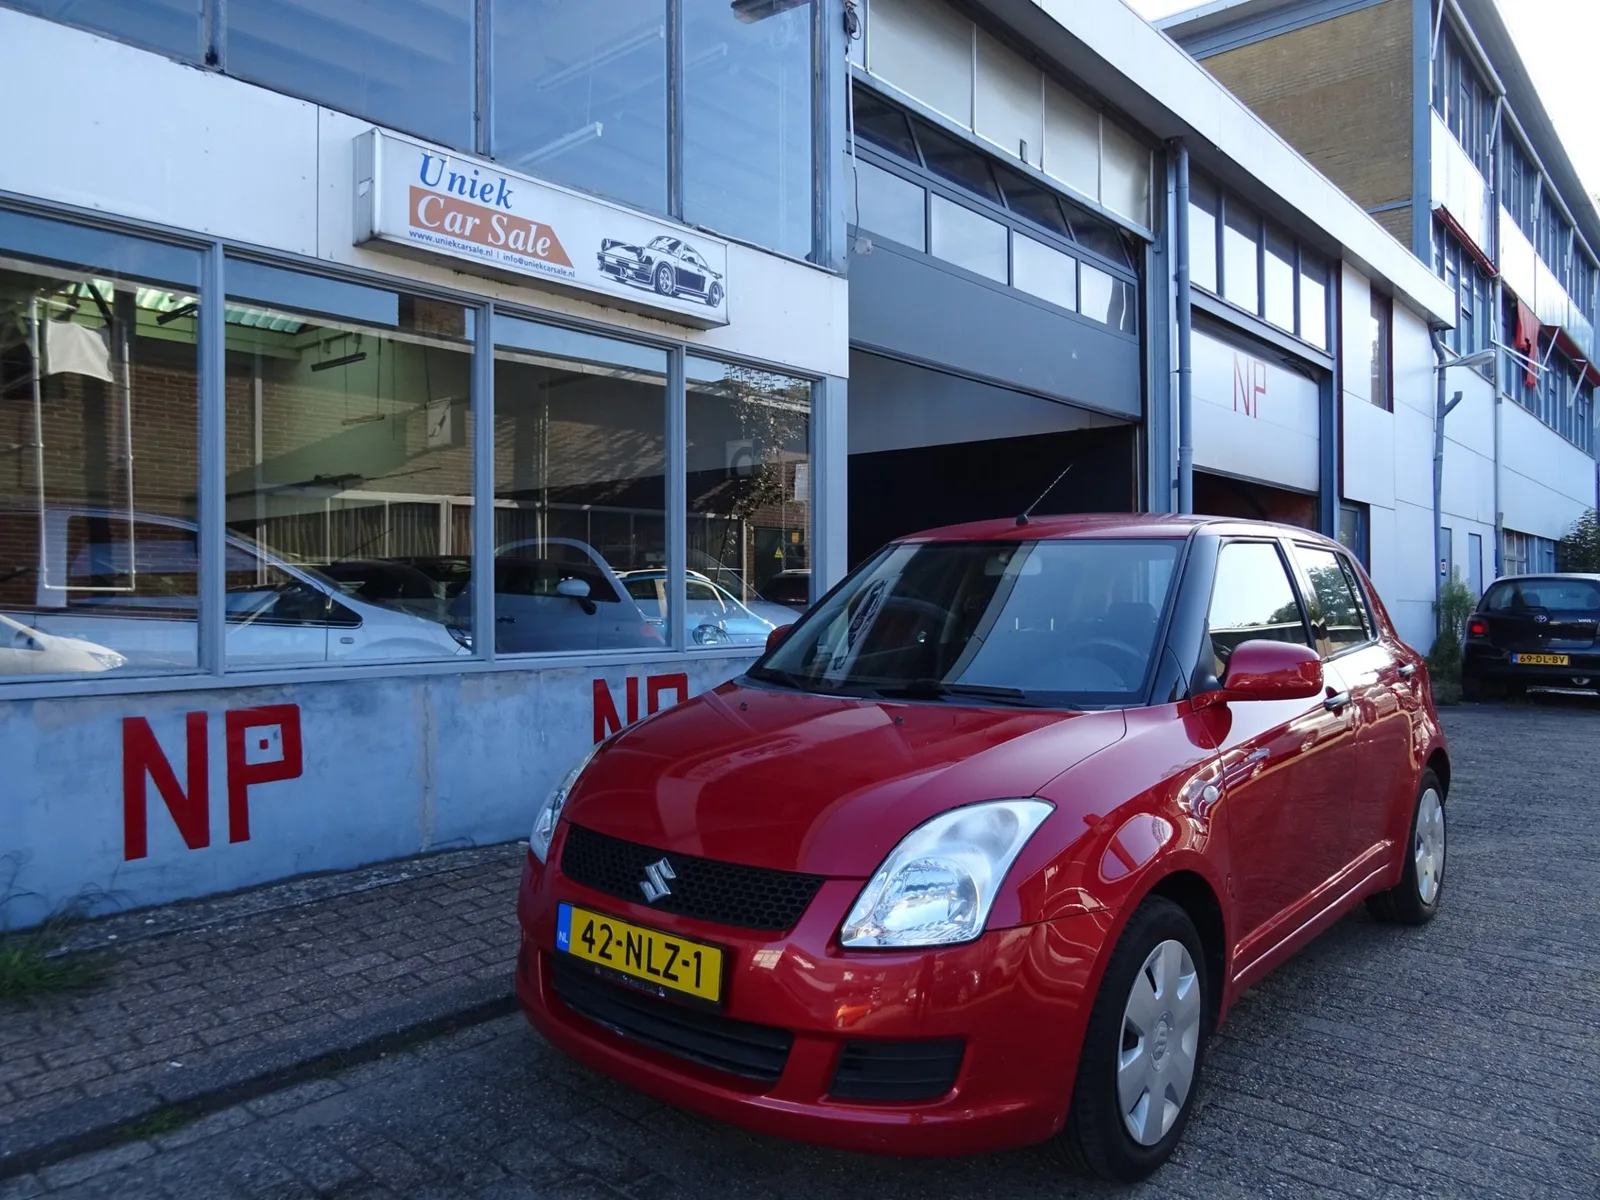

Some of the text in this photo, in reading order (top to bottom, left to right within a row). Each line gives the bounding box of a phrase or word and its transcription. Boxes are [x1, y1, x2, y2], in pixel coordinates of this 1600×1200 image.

[420, 152, 513, 209] Uniek
[408, 229, 576, 279] www.uniekcarsale.nl info@uniekcarsale.nl
[416, 194, 551, 258] Car Sale
[1233, 351, 1267, 419] NP
[1519, 654, 1566, 664] 69-DL-BV
[122, 703, 304, 862] NP
[558, 930, 569, 944] NL
[580, 918, 702, 989] 42-NLZ-1
